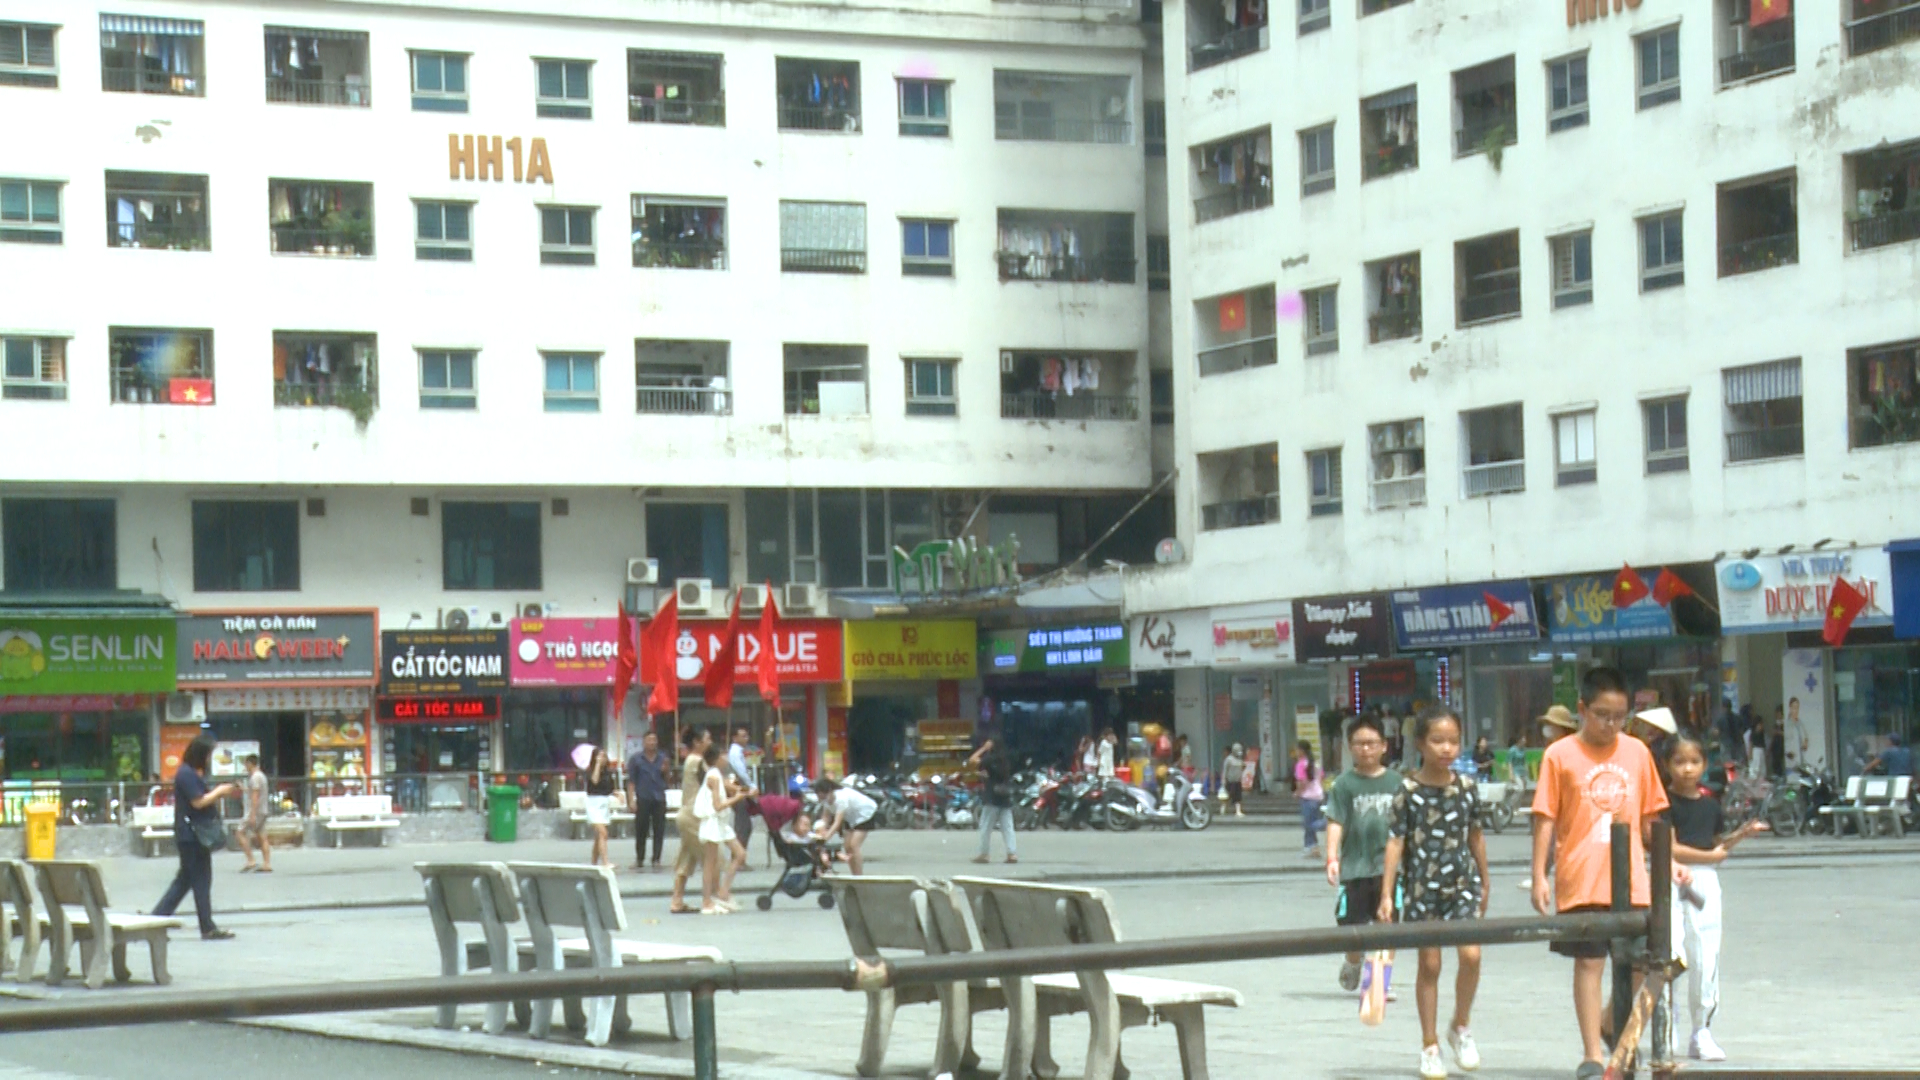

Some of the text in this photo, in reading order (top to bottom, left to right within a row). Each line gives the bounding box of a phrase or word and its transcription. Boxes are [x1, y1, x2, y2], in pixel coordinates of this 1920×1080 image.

[448, 133, 554, 185] HH1A
[222, 616, 317, 633] TIỆM GÀ RÁN
[49, 635, 164, 661] SENLIN
[391, 645, 502, 678] CẮT TÓC NAM
